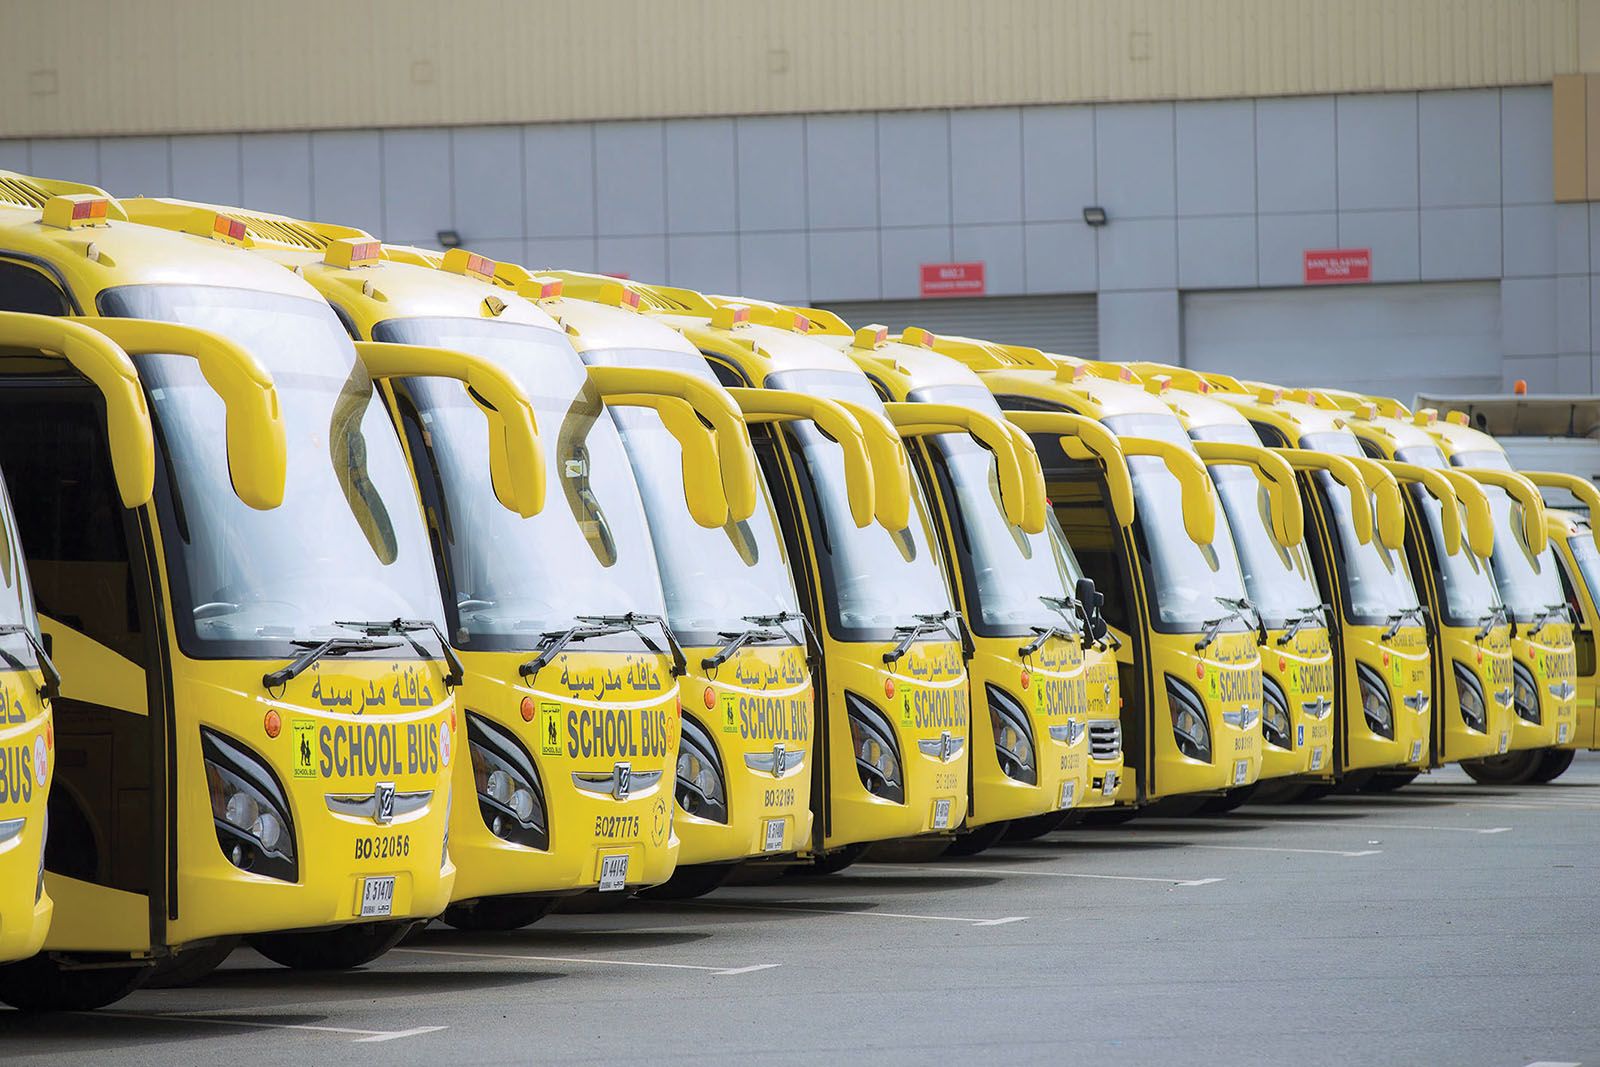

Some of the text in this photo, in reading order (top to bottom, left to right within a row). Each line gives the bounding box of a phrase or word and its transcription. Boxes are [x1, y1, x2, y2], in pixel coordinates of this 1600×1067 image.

[392, 663, 433, 707] حافلة
[627, 655, 661, 691] حافلة
[1220, 670, 1250, 703] SCHOOL
[914, 689, 966, 729] SCHOOL BUS
[1045, 679, 1077, 716] SCHOOL
[567, 710, 636, 759] SCHOOL
[641, 710, 666, 758] BUS
[739, 697, 808, 741] SCHOOL BUS
[319, 724, 402, 778] SCHOOL
[407, 722, 438, 774] BUS
[372, 880, 393, 900] 51470
